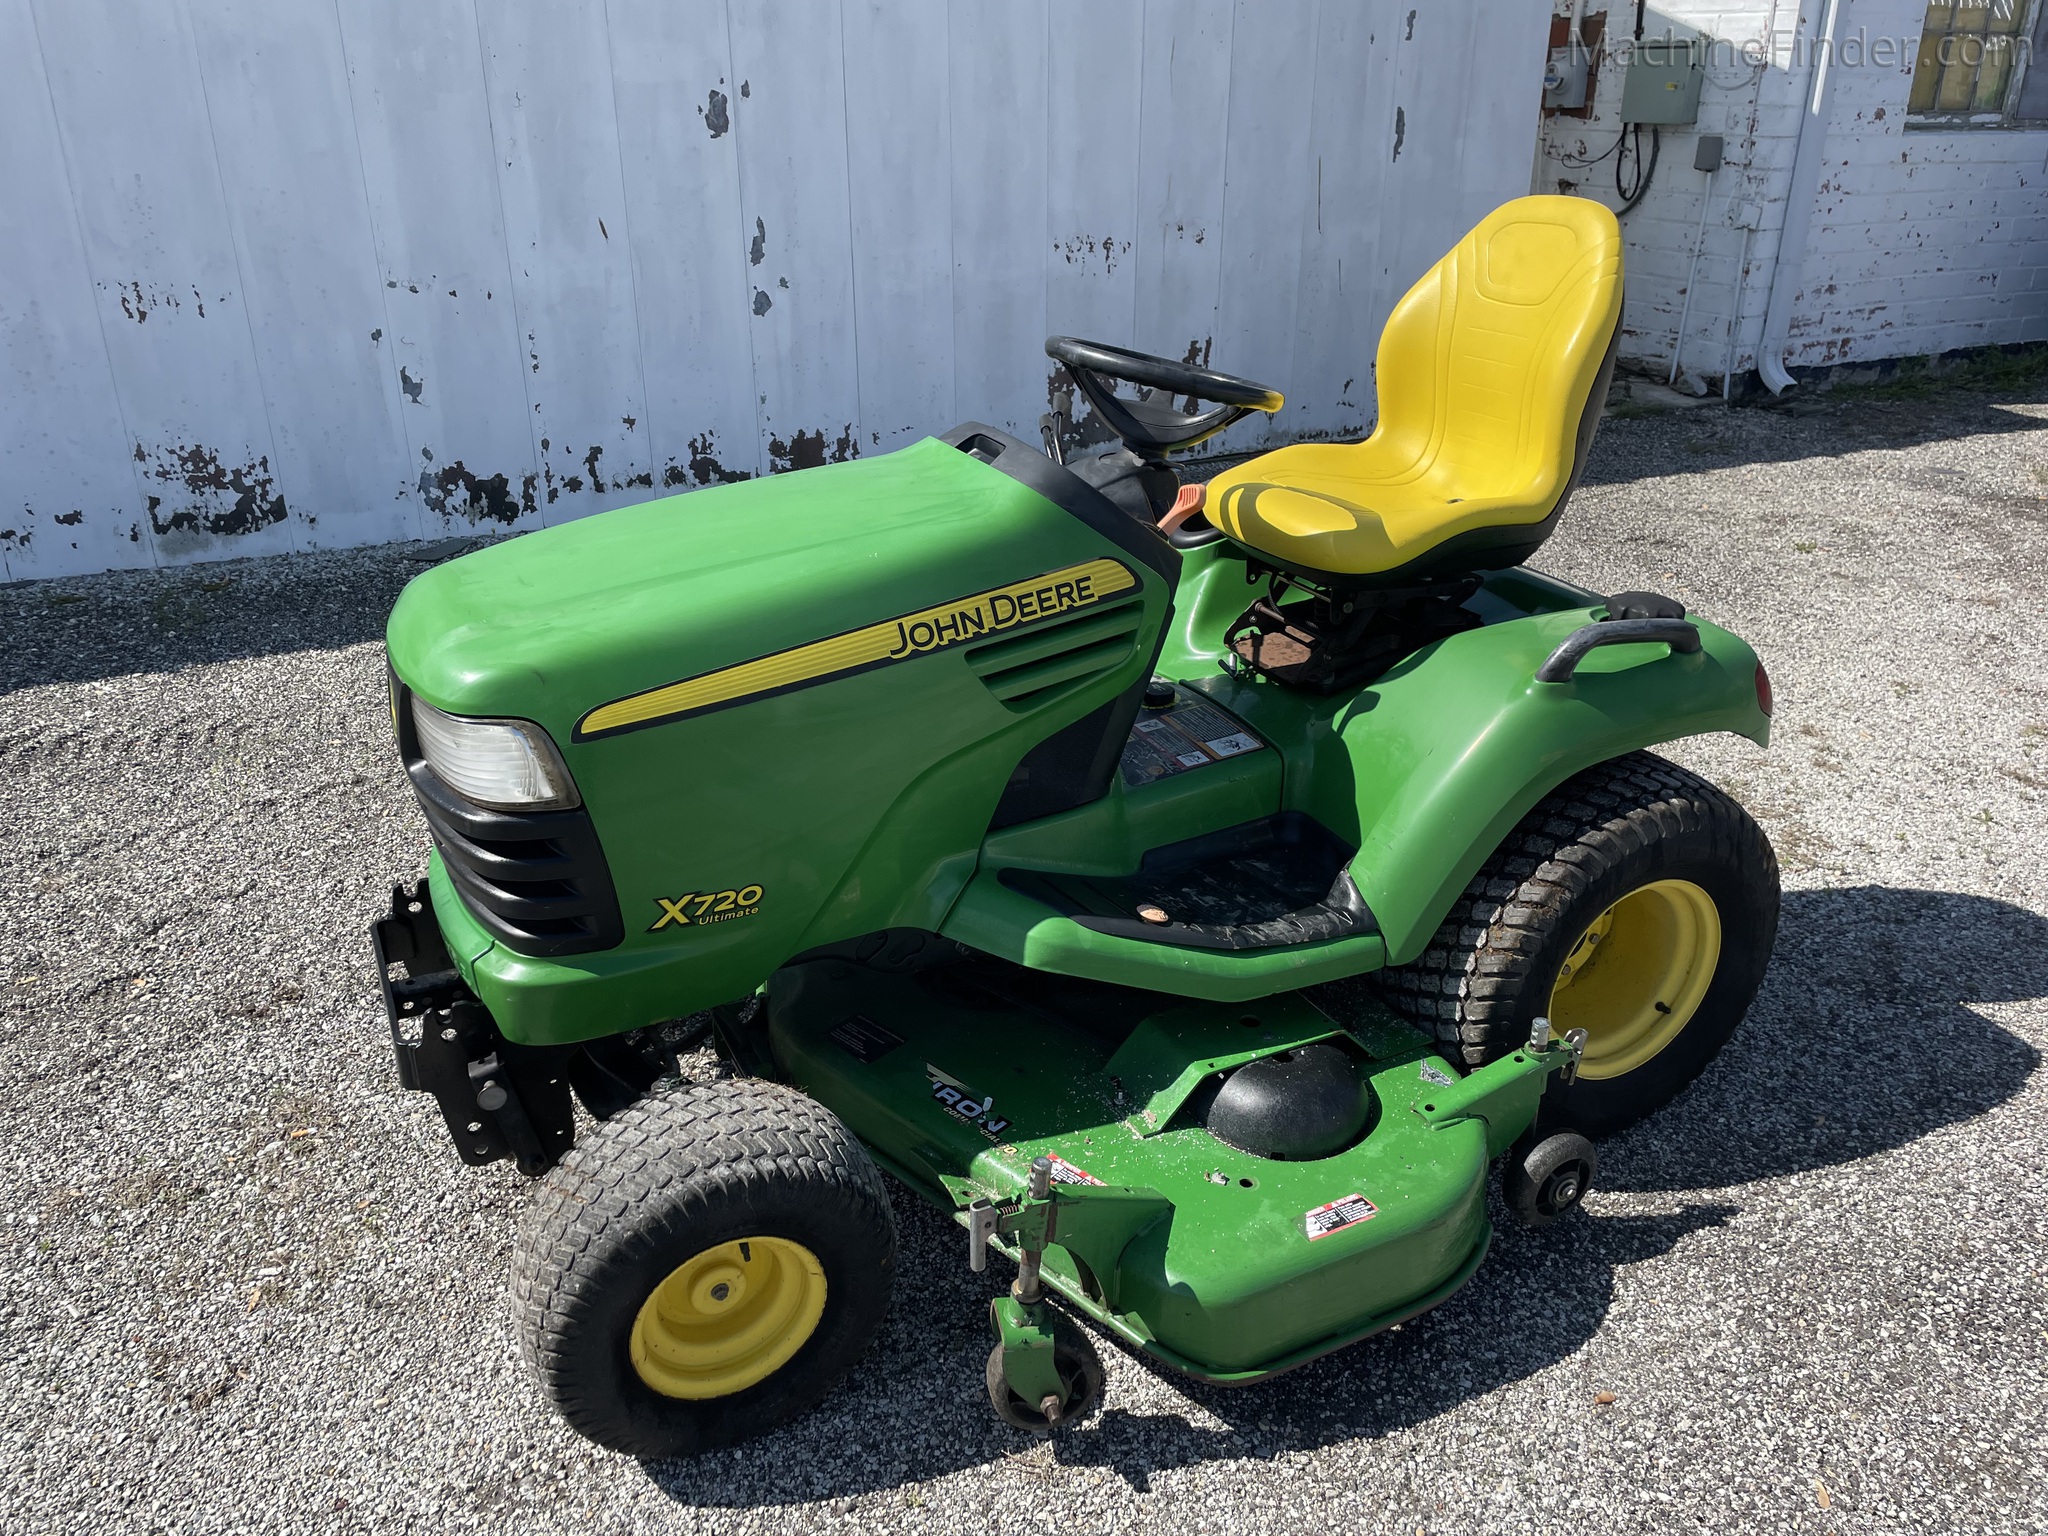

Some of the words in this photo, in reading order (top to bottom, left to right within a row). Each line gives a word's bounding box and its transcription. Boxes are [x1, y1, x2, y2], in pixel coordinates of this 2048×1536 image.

[889, 606, 985, 657] JOHN
[988, 575, 1095, 626] DEERE
[648, 884, 763, 931] X720
[698, 906, 759, 926] Ultimate
